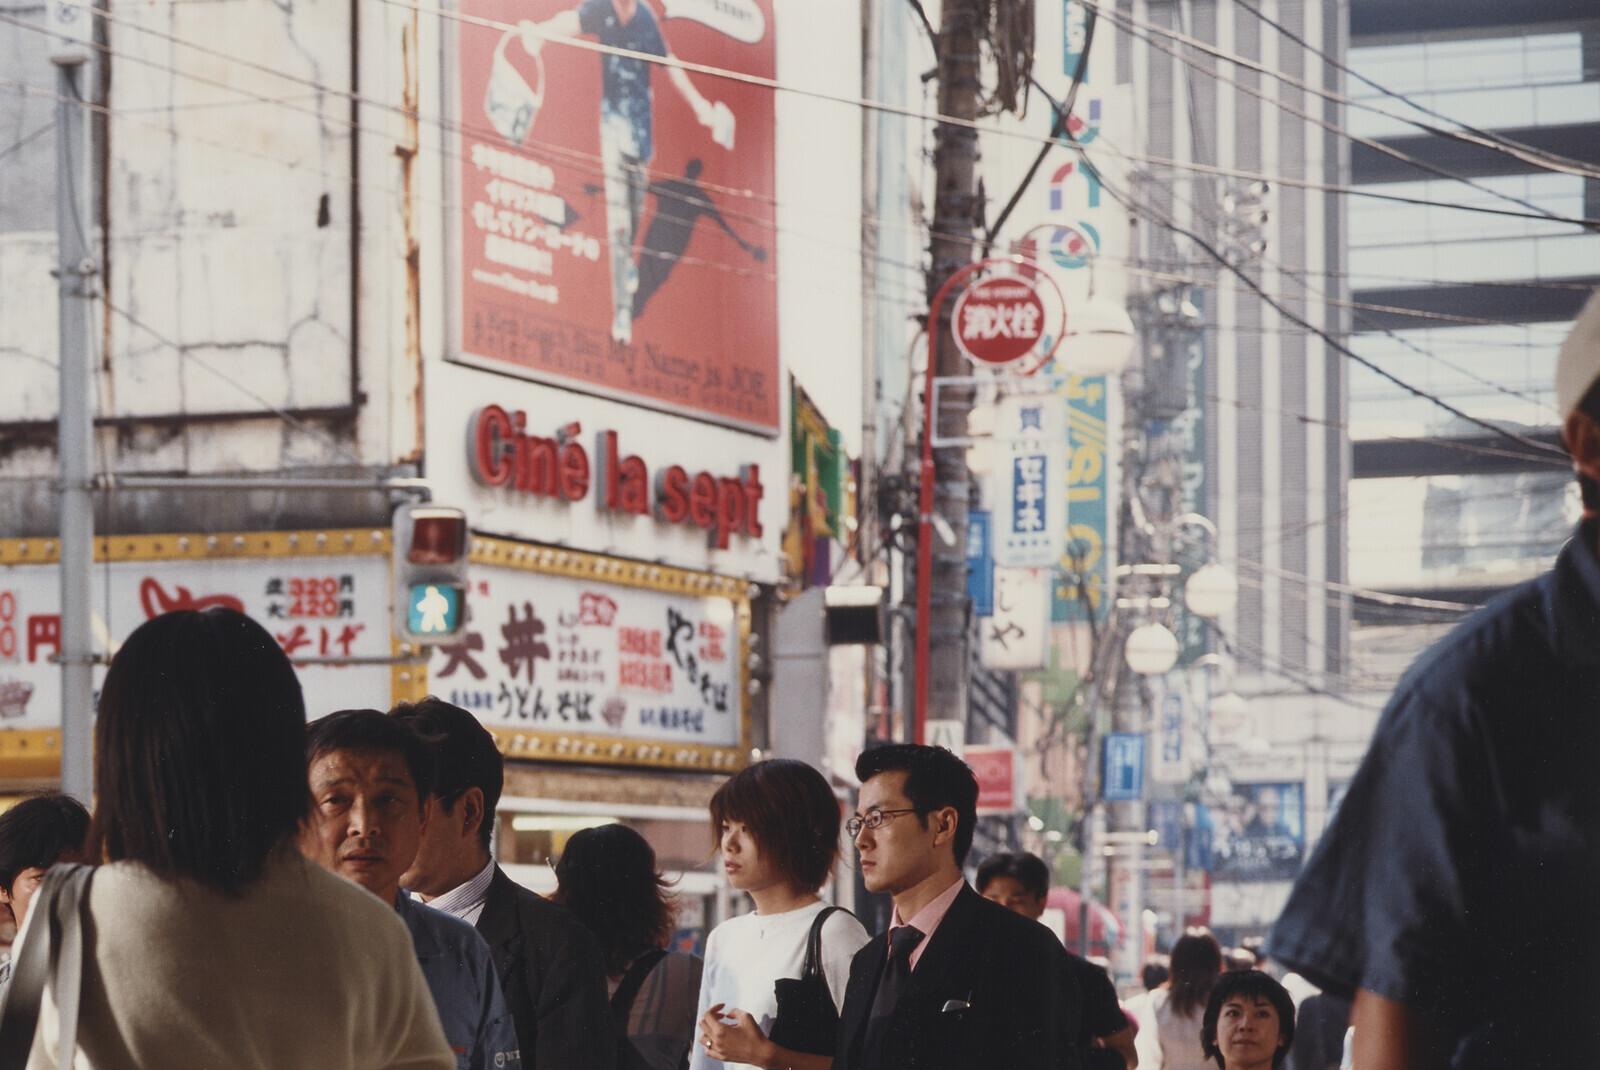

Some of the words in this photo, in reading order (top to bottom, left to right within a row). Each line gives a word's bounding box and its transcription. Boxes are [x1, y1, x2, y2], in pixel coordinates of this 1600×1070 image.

[963, 302, 1041, 340] 消火栓
[475, 404, 590, 502] Ciné
[603, 430, 648, 516] la
[662, 463, 764, 550] sept
